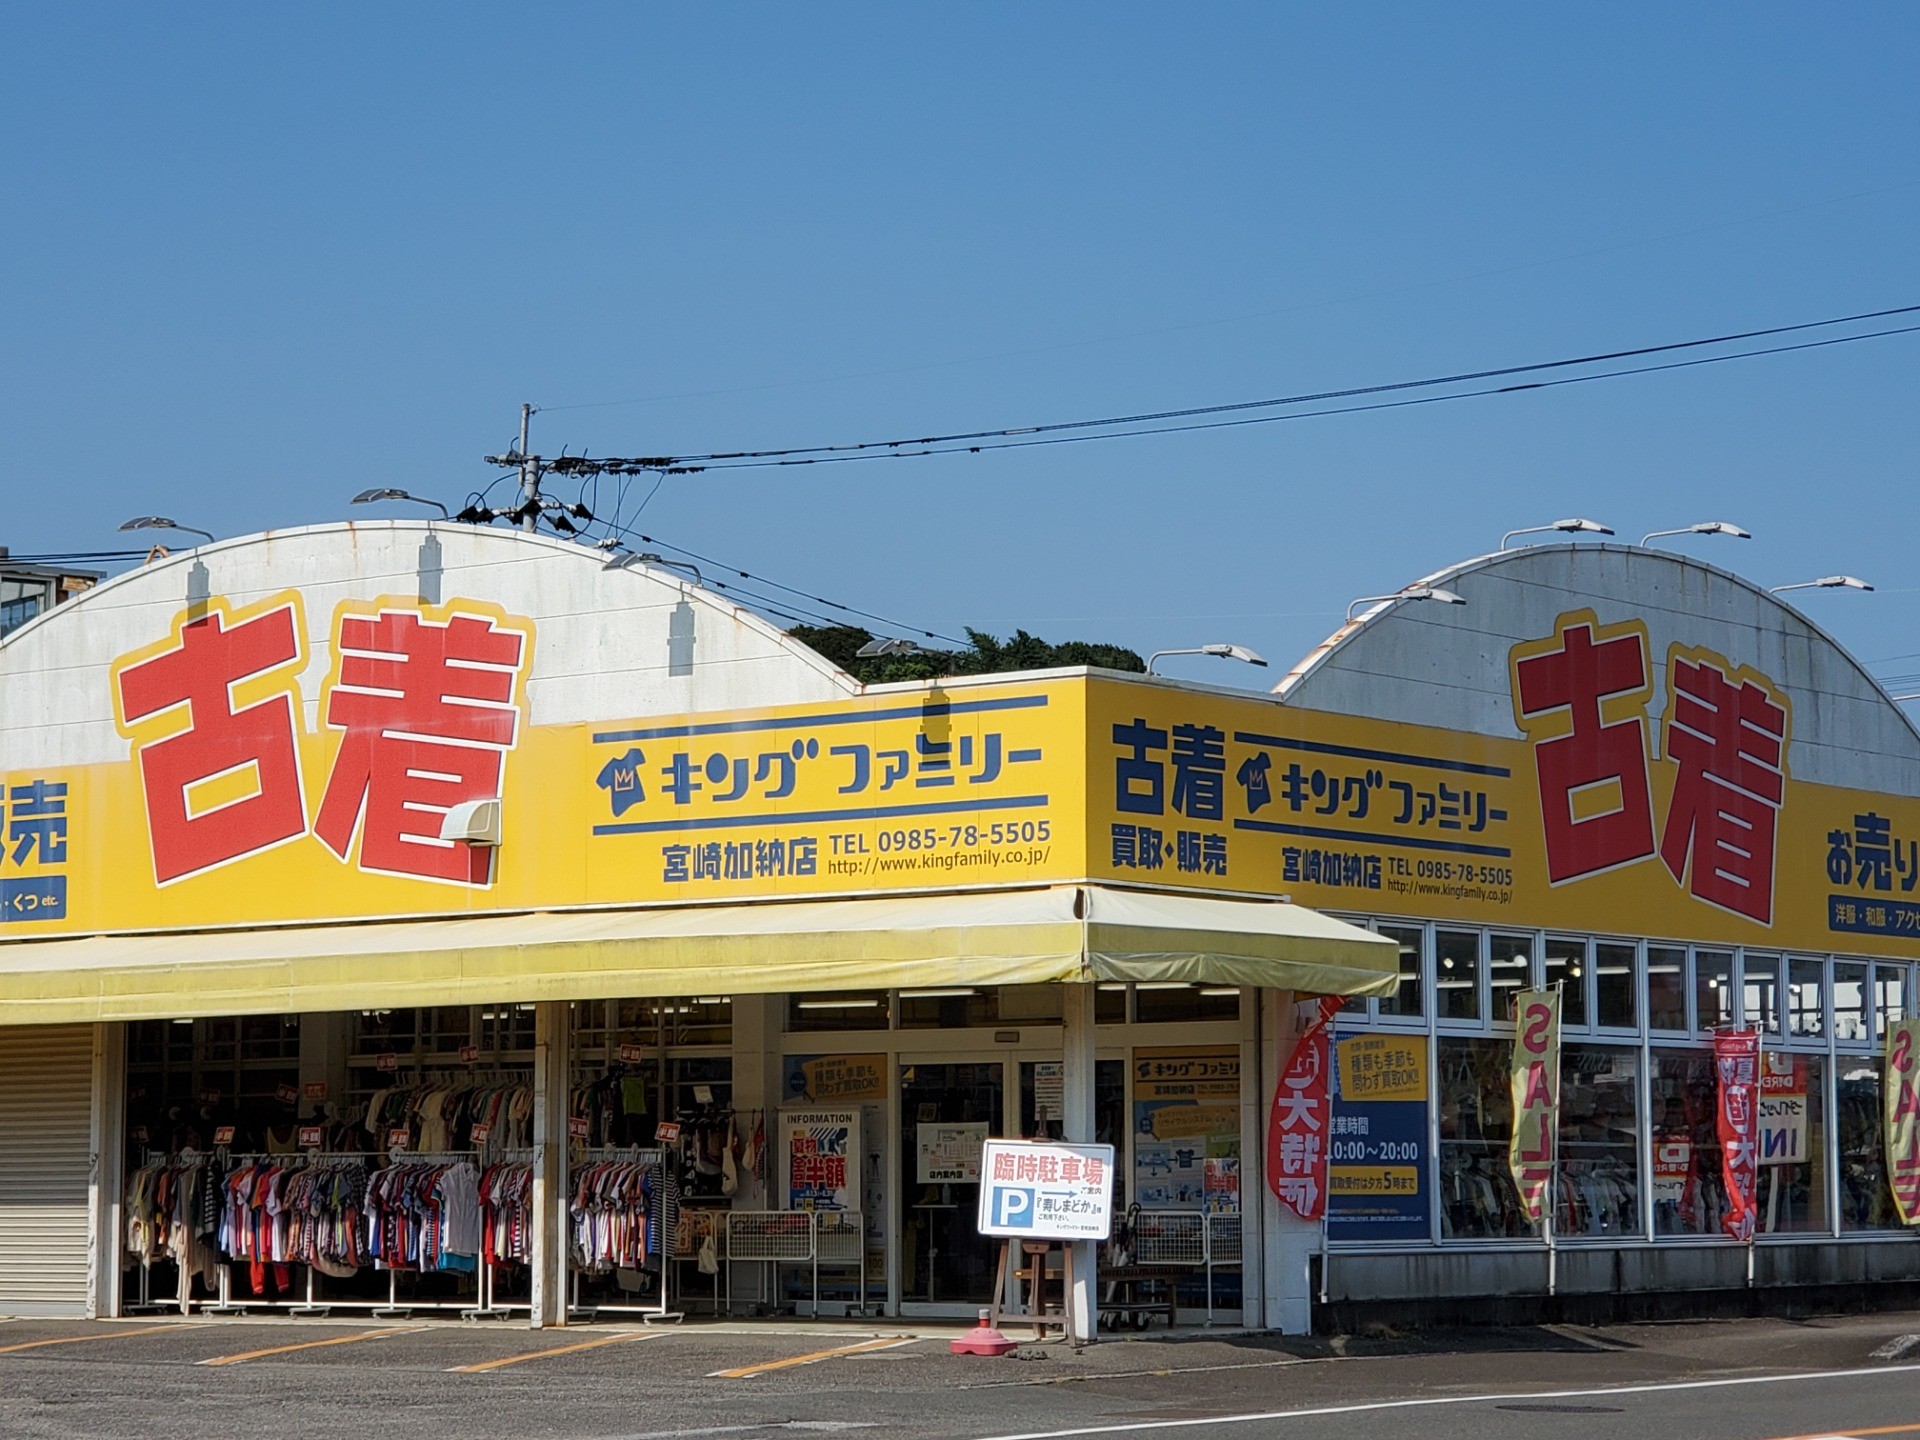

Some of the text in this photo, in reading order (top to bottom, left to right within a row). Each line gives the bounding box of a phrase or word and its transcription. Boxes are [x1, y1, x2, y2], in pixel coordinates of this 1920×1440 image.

[118, 602, 526, 888] 古着
[661, 733, 1043, 805] キングファミリー
[1112, 718, 1226, 821] 古着
[1515, 620, 1786, 929] 古着
[1282, 764, 1508, 832] キングファミリー
[0, 780, 68, 868] 売
[829, 820, 1051, 854] TEL 0985-78-5505
[662, 836, 818, 883] 宮崎加納店
[828, 844, 1052, 875] http://www.kingfamily.co.jp/
[1282, 846, 1382, 889] 宮崎加納店
[1826, 812, 1918, 891] お売り
[1387, 878, 1513, 904] http://www.kingfamily.co.jp/
[1388, 857, 1513, 886] TEL 0985-78-5505
[1351, 1050, 1416, 1073] 種類も季節も
[787, 1114, 852, 1124] INFORMATION
[993, 1152, 1104, 1185] 臨時駐車場
[1001, 1189, 1029, 1225] P
[1080, 1187, 1102, 1195] ご案内
